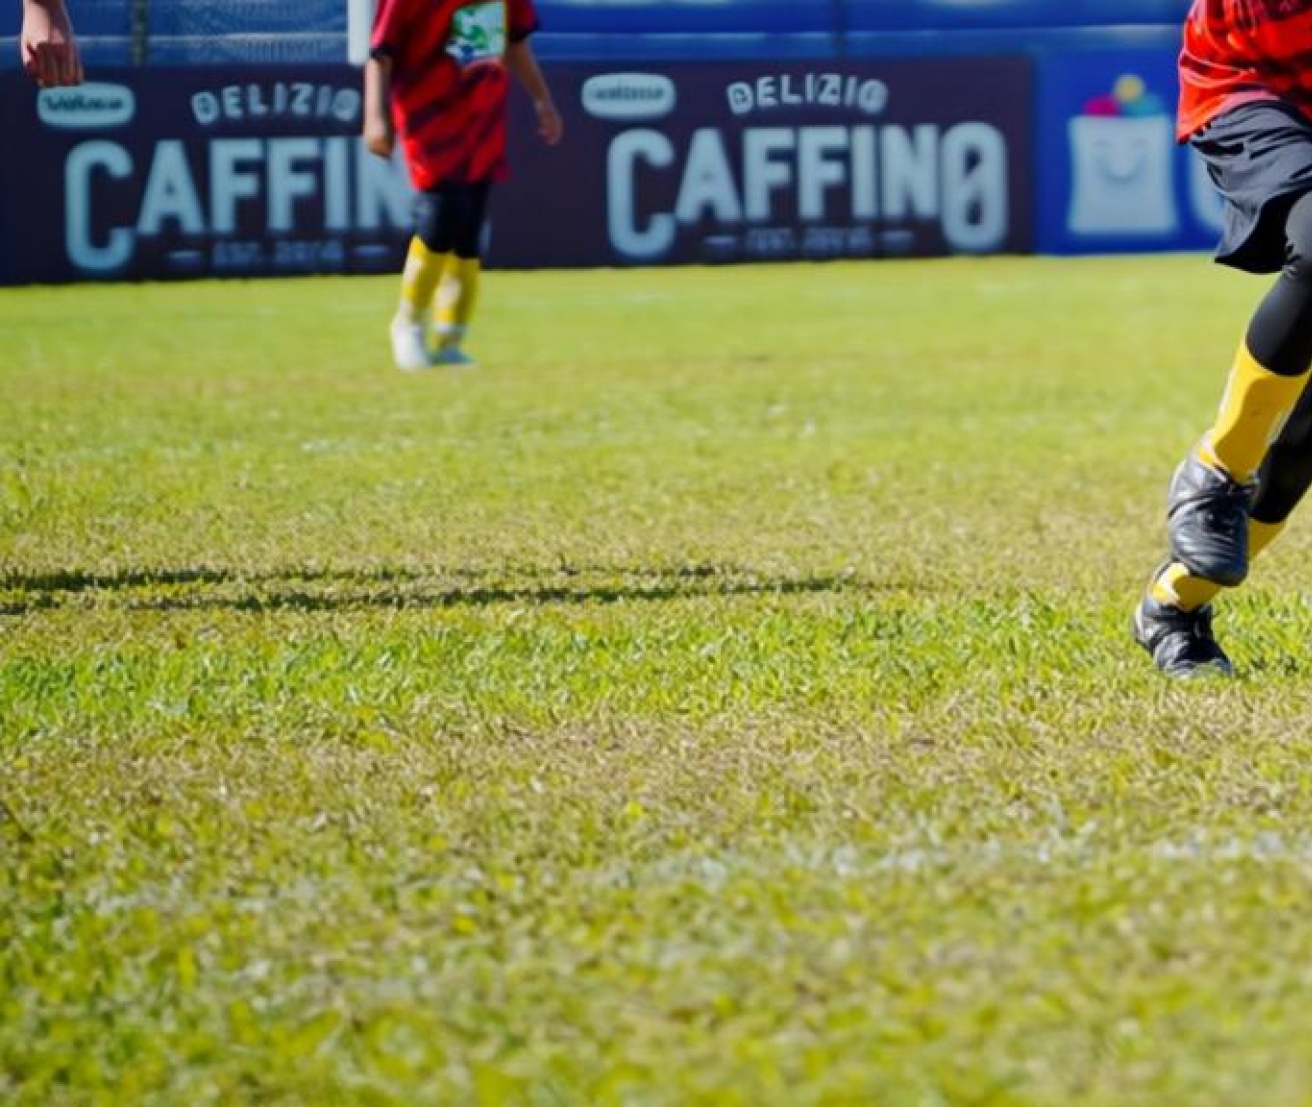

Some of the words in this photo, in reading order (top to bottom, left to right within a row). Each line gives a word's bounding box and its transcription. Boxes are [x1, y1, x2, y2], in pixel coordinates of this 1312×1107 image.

[190, 82, 361, 125] DELIZIO
[727, 73, 889, 115] DELIZIO
[64, 139, 416, 270] CAFFIN
